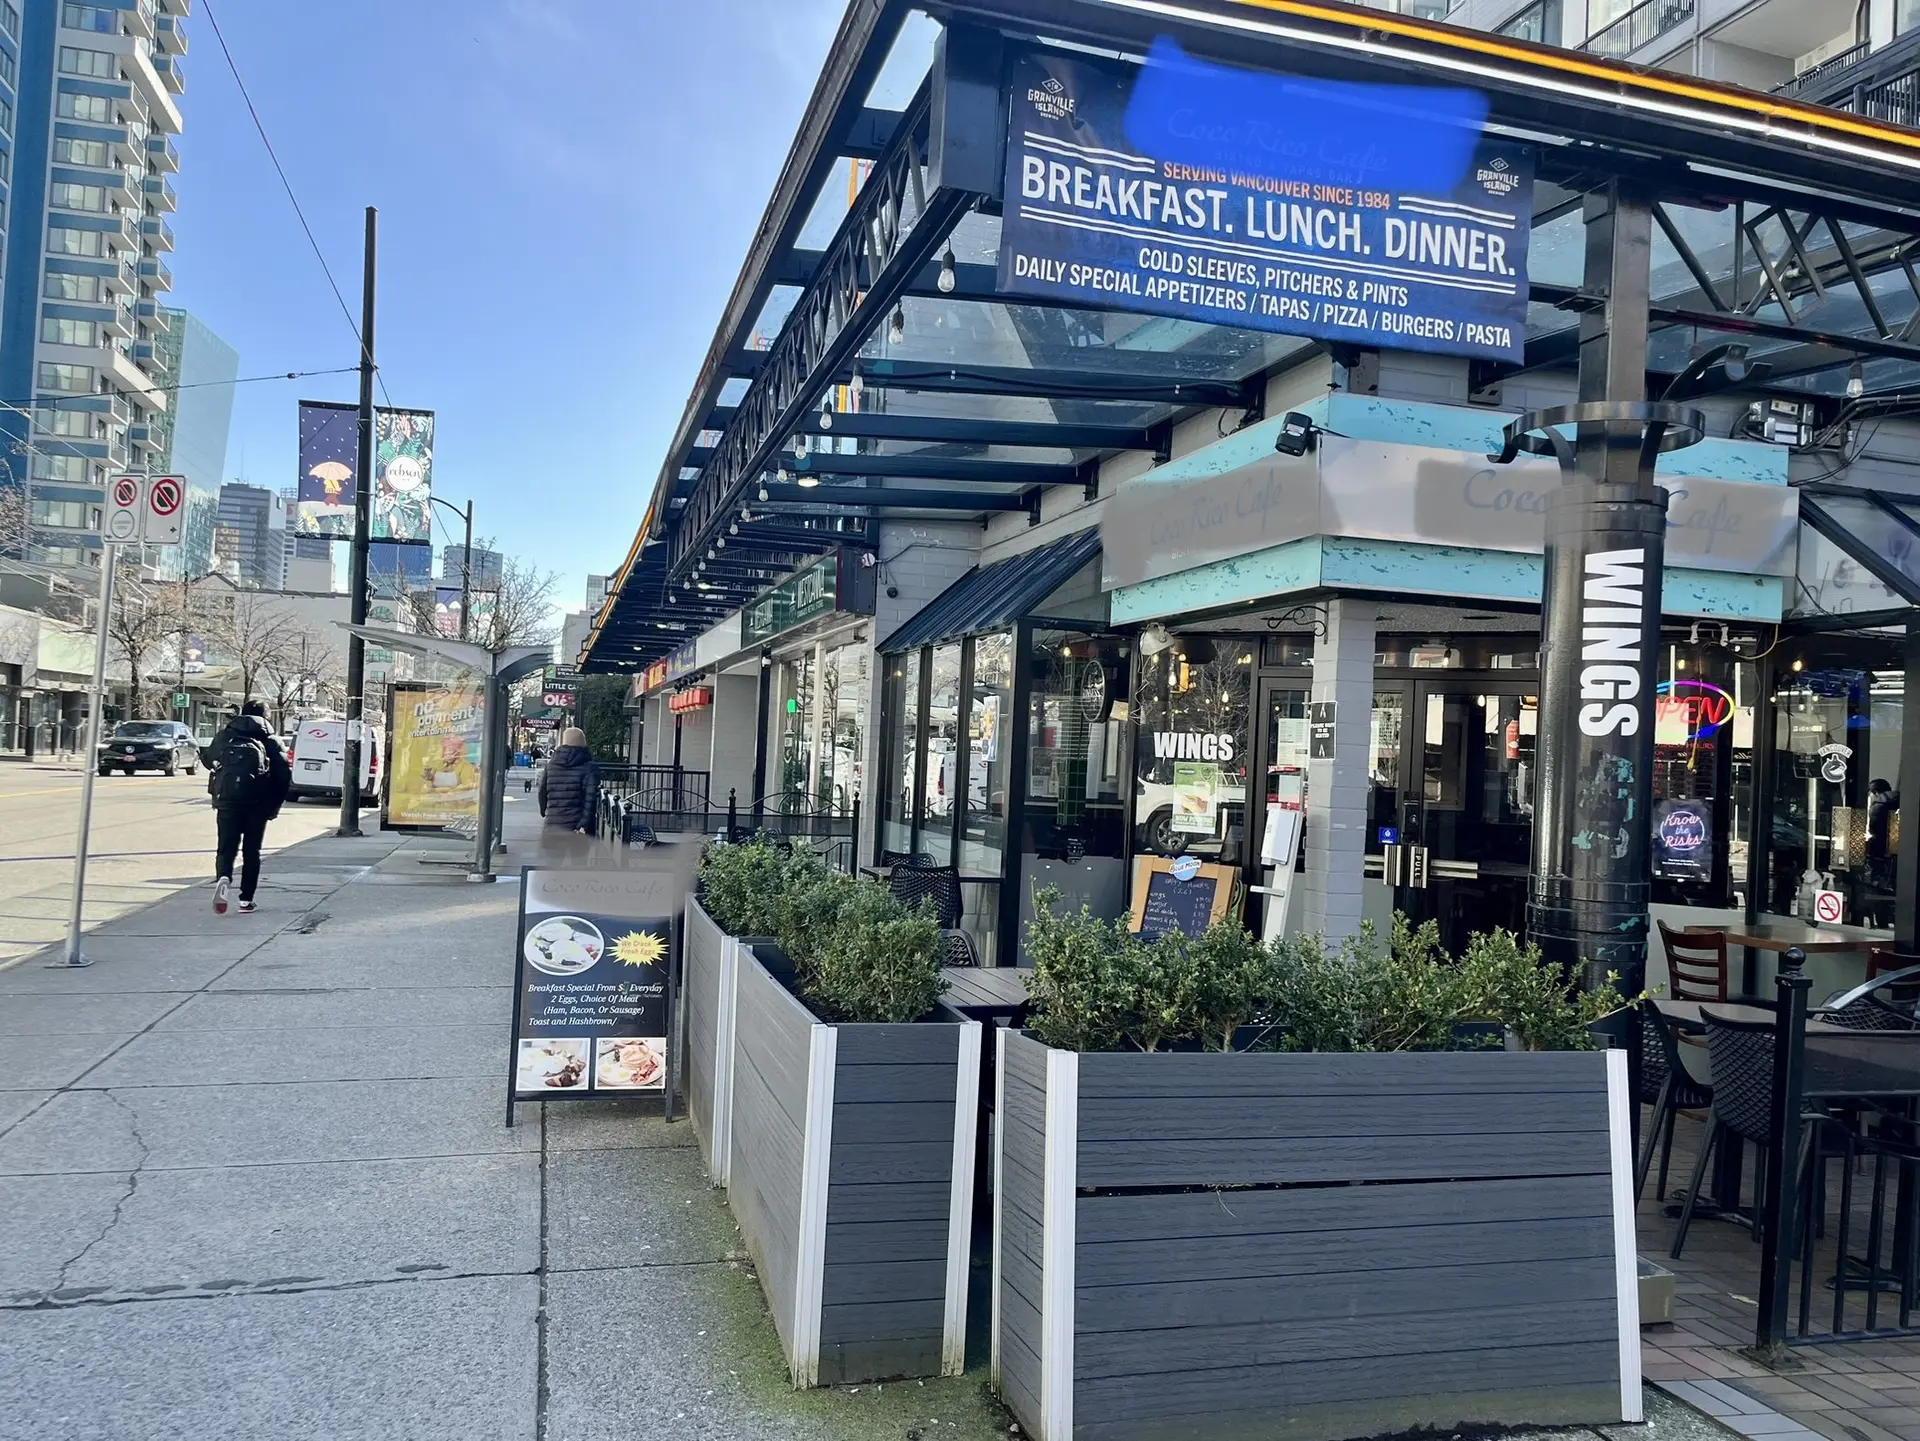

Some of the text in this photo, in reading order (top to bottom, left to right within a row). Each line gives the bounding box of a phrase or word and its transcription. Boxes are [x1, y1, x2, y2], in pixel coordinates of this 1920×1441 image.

[1027, 88, 1075, 113] GRANVILLE
[1035, 102, 1065, 117] ISLAND
[1163, 161, 1391, 210] SERVING VANCOUVER SINCE 1984
[1476, 169, 1520, 187] GRANVILLE
[1483, 181, 1511, 192] ISLAND
[1022, 154, 1516, 276] BREAKFAST. LUNCH. DINNER.
[1139, 247, 1408, 307] COLD SLEEVES, PITCHERS & PINTS
[1015, 254, 1511, 347] DAILY SPECIAL APPETIZERS / TAPAS / PIZZA / BURGERS / PASTA
[389, 463, 421, 479] robson
[1578, 548, 1645, 737] WINGS
[543, 694, 568, 707] Olé
[414, 700, 434, 717] no
[1655, 696, 1726, 724] PEN
[418, 705, 475, 728] payment
[407, 723, 467, 739] entertainment
[1154, 732, 1234, 760] WINGS
[1819, 744, 1853, 757] VANCOUVER
[1663, 814, 1701, 828] Know
[1675, 825, 1690, 835] the
[1664, 834, 1701, 848] Risks
[1170, 861, 1200, 872] BLUE MOON
[1414, 855, 1422, 877] PULL
[621, 940, 632, 948] We
[639, 948, 656, 956] Eggs
[528, 983, 566, 993] Breakfast
[566, 983, 595, 993] Special
[596, 984, 616, 992] From
[629, 983, 664, 994] Everyday
[551, 995, 557, 1003] 2
[558, 995, 578, 1005] Eggs,
[580, 995, 606, 1003] Choice
[607, 995, 618, 1003] Of
[619, 995, 639, 1003] Meat
[543, 1006, 567, 1016] (Ham,
[569, 1006, 596, 1015] Bacon,
[609, 1006, 645, 1016] Sausage)
[529, 1018, 550, 1026] Toast
[551, 1018, 566, 1026] and
